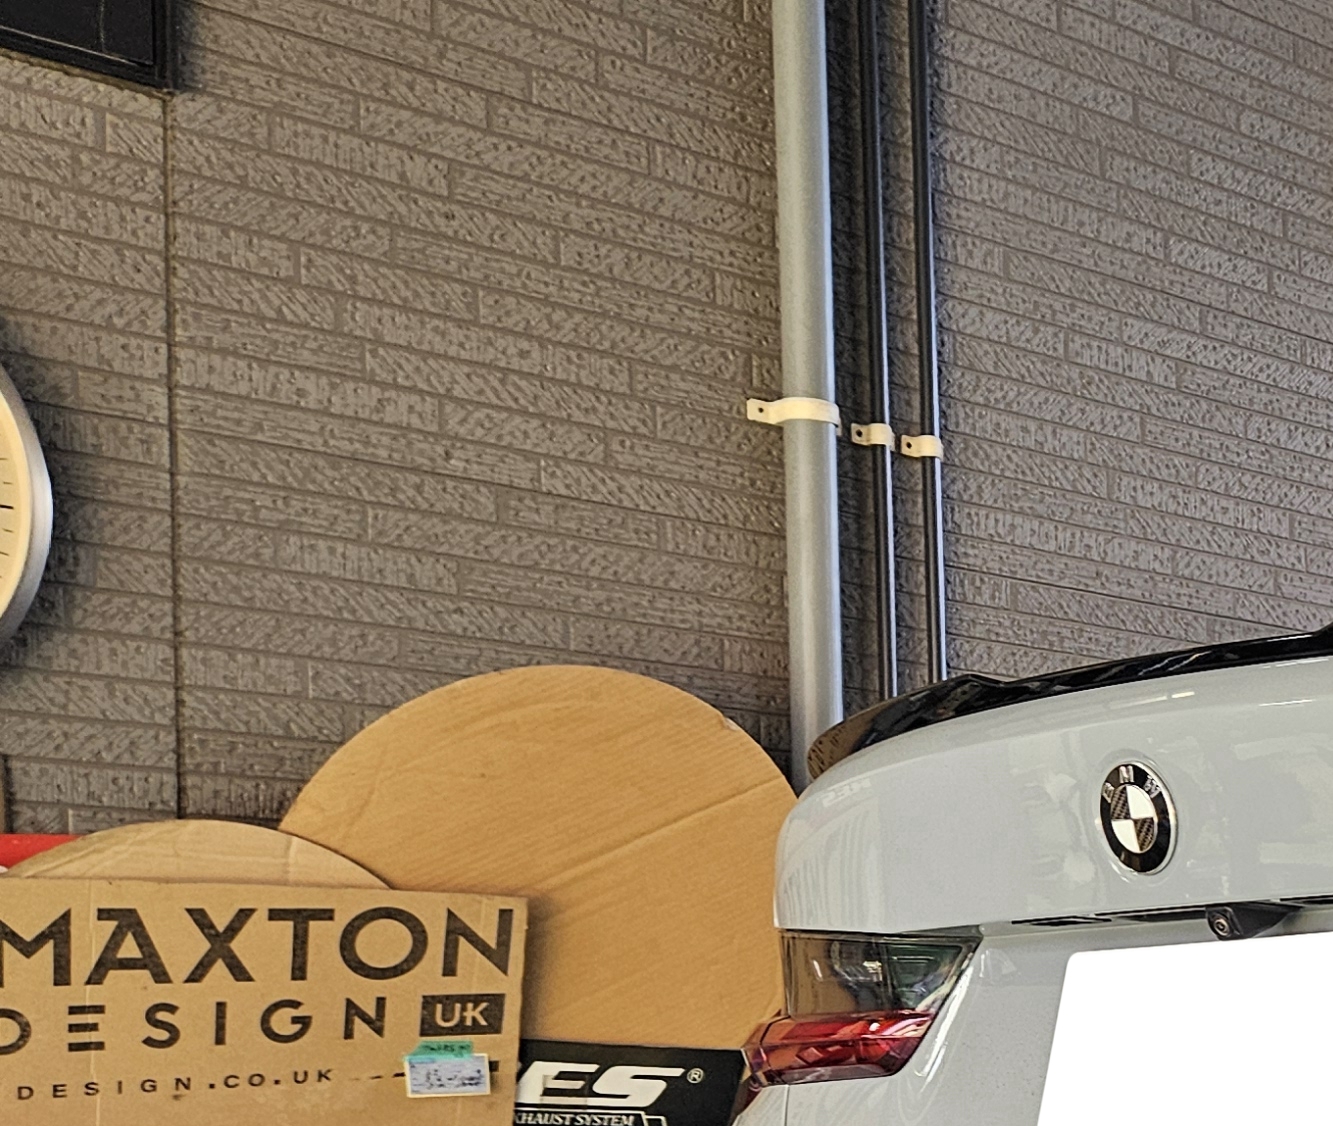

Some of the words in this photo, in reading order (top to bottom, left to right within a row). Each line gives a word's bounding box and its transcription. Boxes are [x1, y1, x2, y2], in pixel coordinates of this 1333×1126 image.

[0, 907, 514, 988] MAXTON
[0, 997, 387, 1056] DESIGN
[435, 1002, 490, 1027] UK
[517, 1061, 686, 1108] ES
[575, 1114, 635, 1126] SYSTEM
